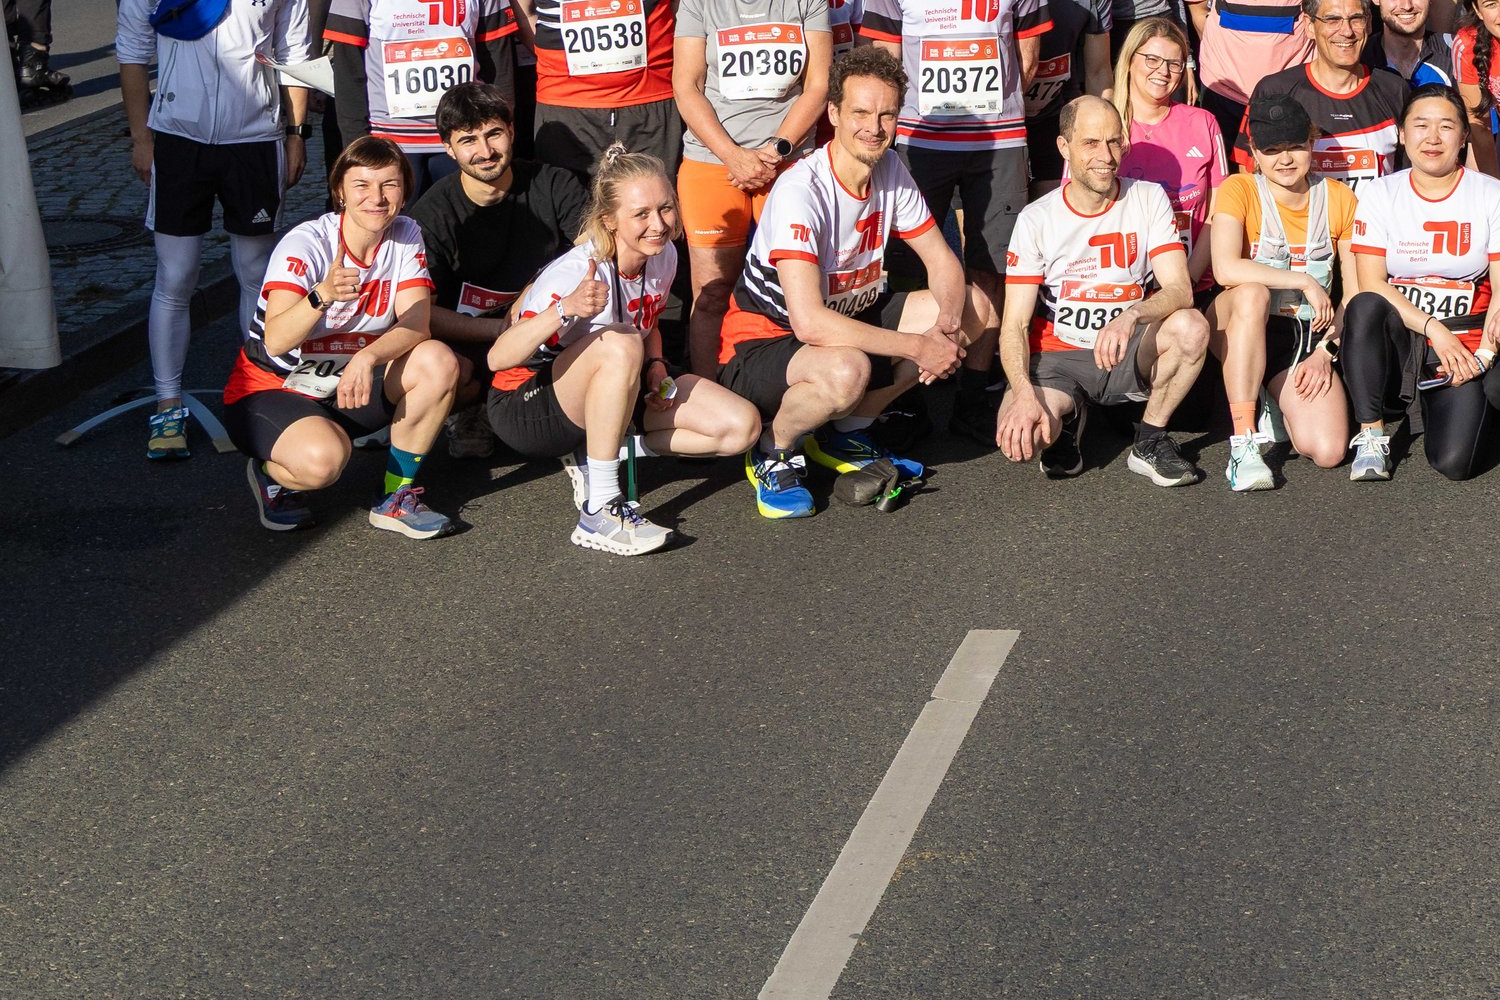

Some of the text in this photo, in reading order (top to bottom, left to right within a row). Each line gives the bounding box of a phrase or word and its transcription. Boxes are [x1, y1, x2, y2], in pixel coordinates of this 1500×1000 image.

[924, 7, 958, 16] Technische
[924, 15, 958, 24] Universität
[392, 20, 426, 28] Universität
[564, 20, 644, 54] 20538
[722, 49, 803, 78] 20386
[388, 63, 471, 95] 16030
[922, 66, 999, 94] 20372
[1064, 265, 1098, 275] Universität
[294, 360, 348, 378] 204
